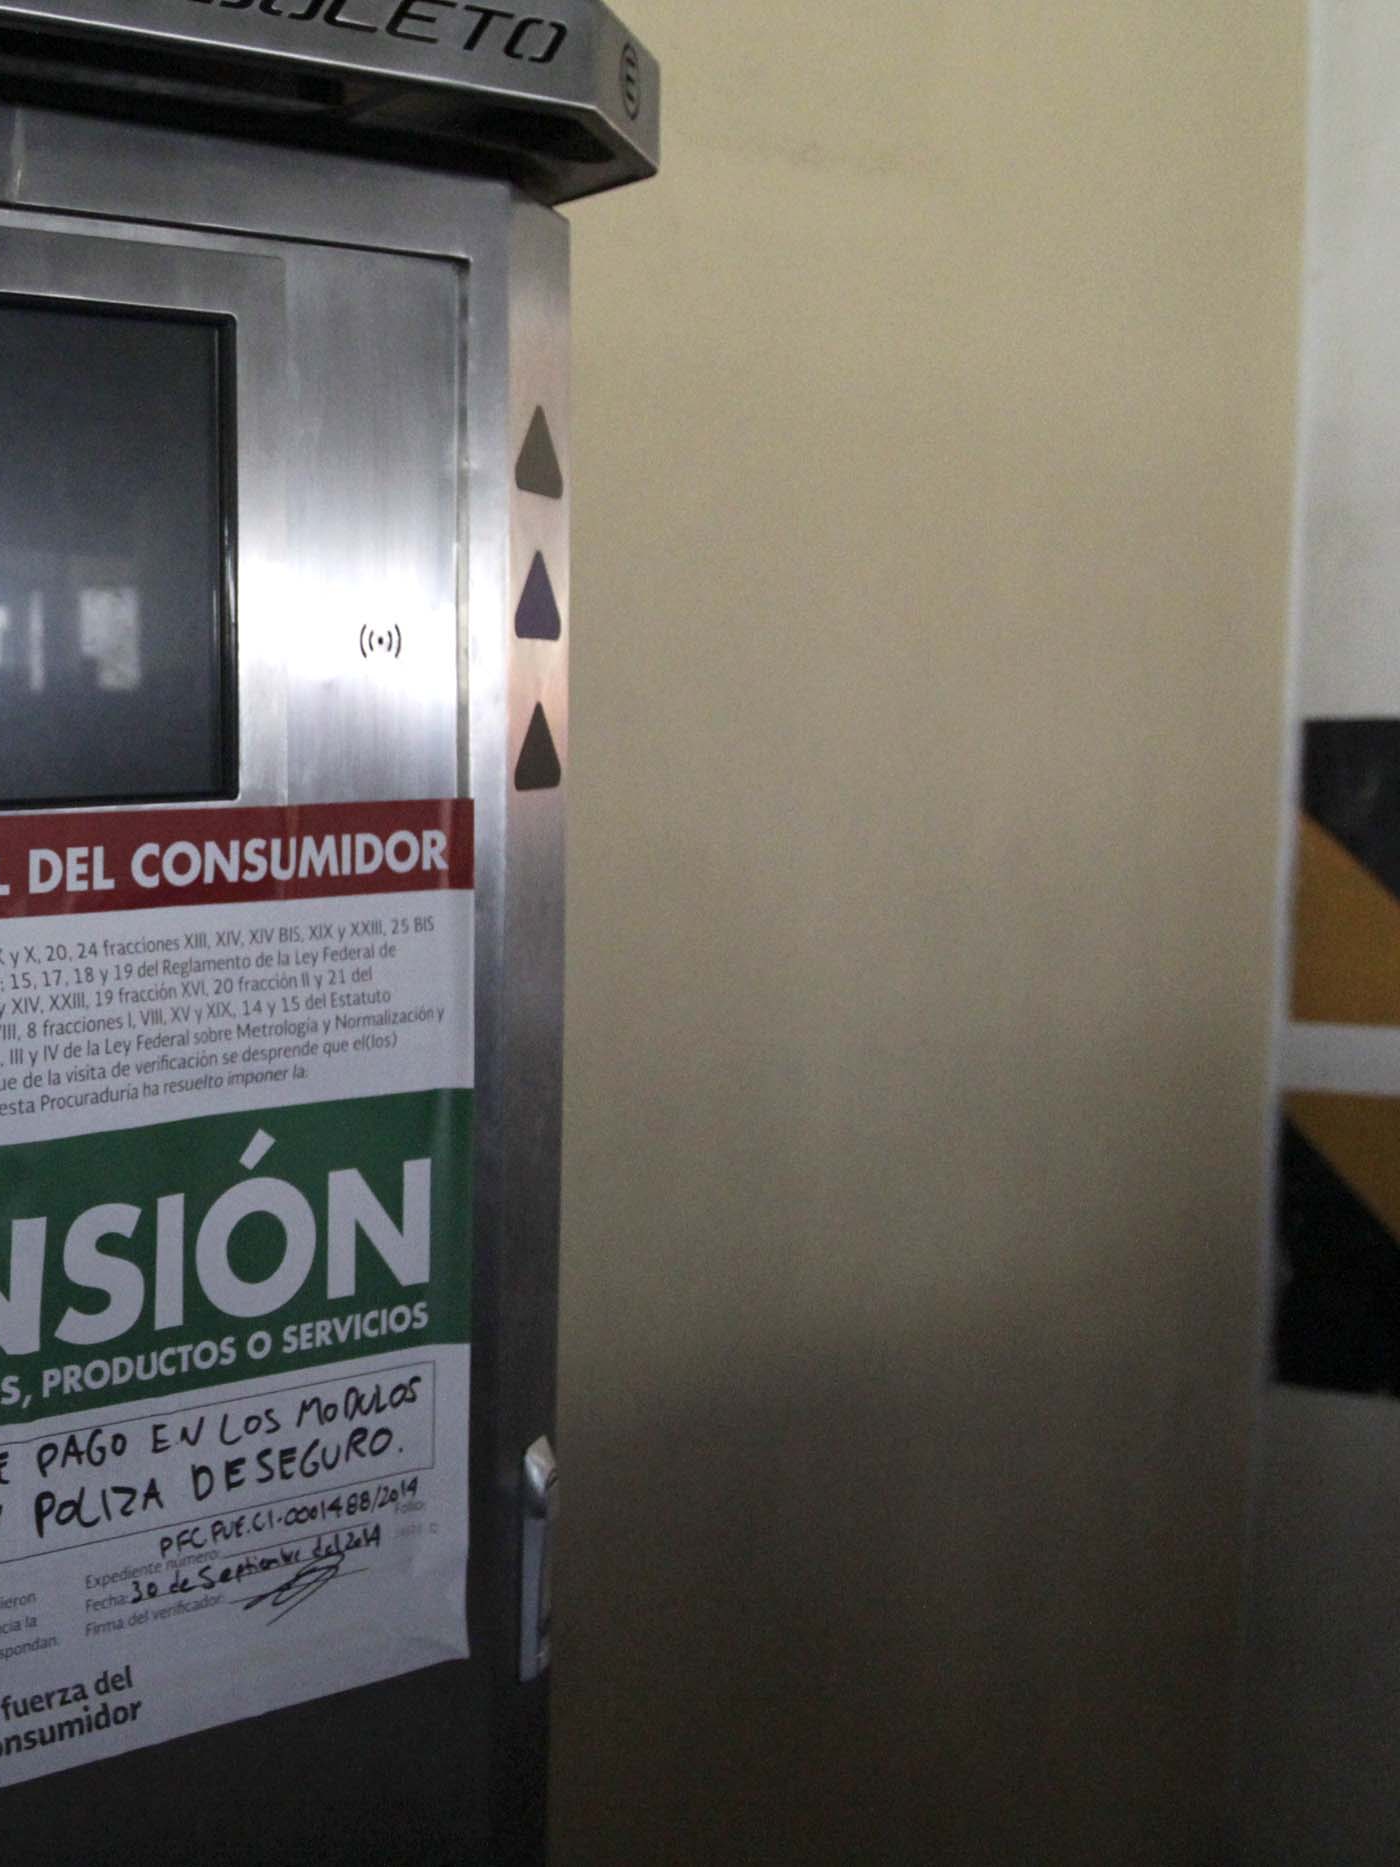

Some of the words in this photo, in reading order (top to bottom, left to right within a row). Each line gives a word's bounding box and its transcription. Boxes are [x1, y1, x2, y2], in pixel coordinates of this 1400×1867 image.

[190, 0, 568, 63] LETO
[28, 846, 116, 894] DEL
[130, 829, 448, 889] CONSUMIDOR
[103, 939, 179, 956] fracciones
[163, 956, 251, 978] Reglamento
[330, 990, 391, 1008] Estatuto
[237, 1020, 318, 1039] Metrología
[66, 1067, 106, 1083] visita
[135, 1054, 218, 1074] verificación
[242, 1041, 318, 1064] desprende
[41, 1087, 138, 1111] Procuraduría
[164, 1075, 223, 1094] resuelto
[227, 1069, 288, 1087] imponer
[42, 1333, 237, 1398] PRODUCTOS
[247, 1330, 272, 1360] O
[281, 1301, 429, 1352] SERVICIOS
[37, 1428, 127, 1478] PAGO
[151, 1416, 205, 1454] EN
[220, 1408, 281, 1446] LOS
[296, 1376, 421, 1430] MODULOS
[35, 1478, 164, 1538] POLIZA
[85, 1562, 162, 1590] Expediente
[132, 1581, 159, 1603] 30
[169, 1573, 198, 1594] de
[25, 1616, 37, 1628] la
[85, 1619, 124, 1637] Firma
[127, 1610, 151, 1627] del
[2, 1675, 89, 1723] fuerza
[95, 1665, 134, 1695] del
